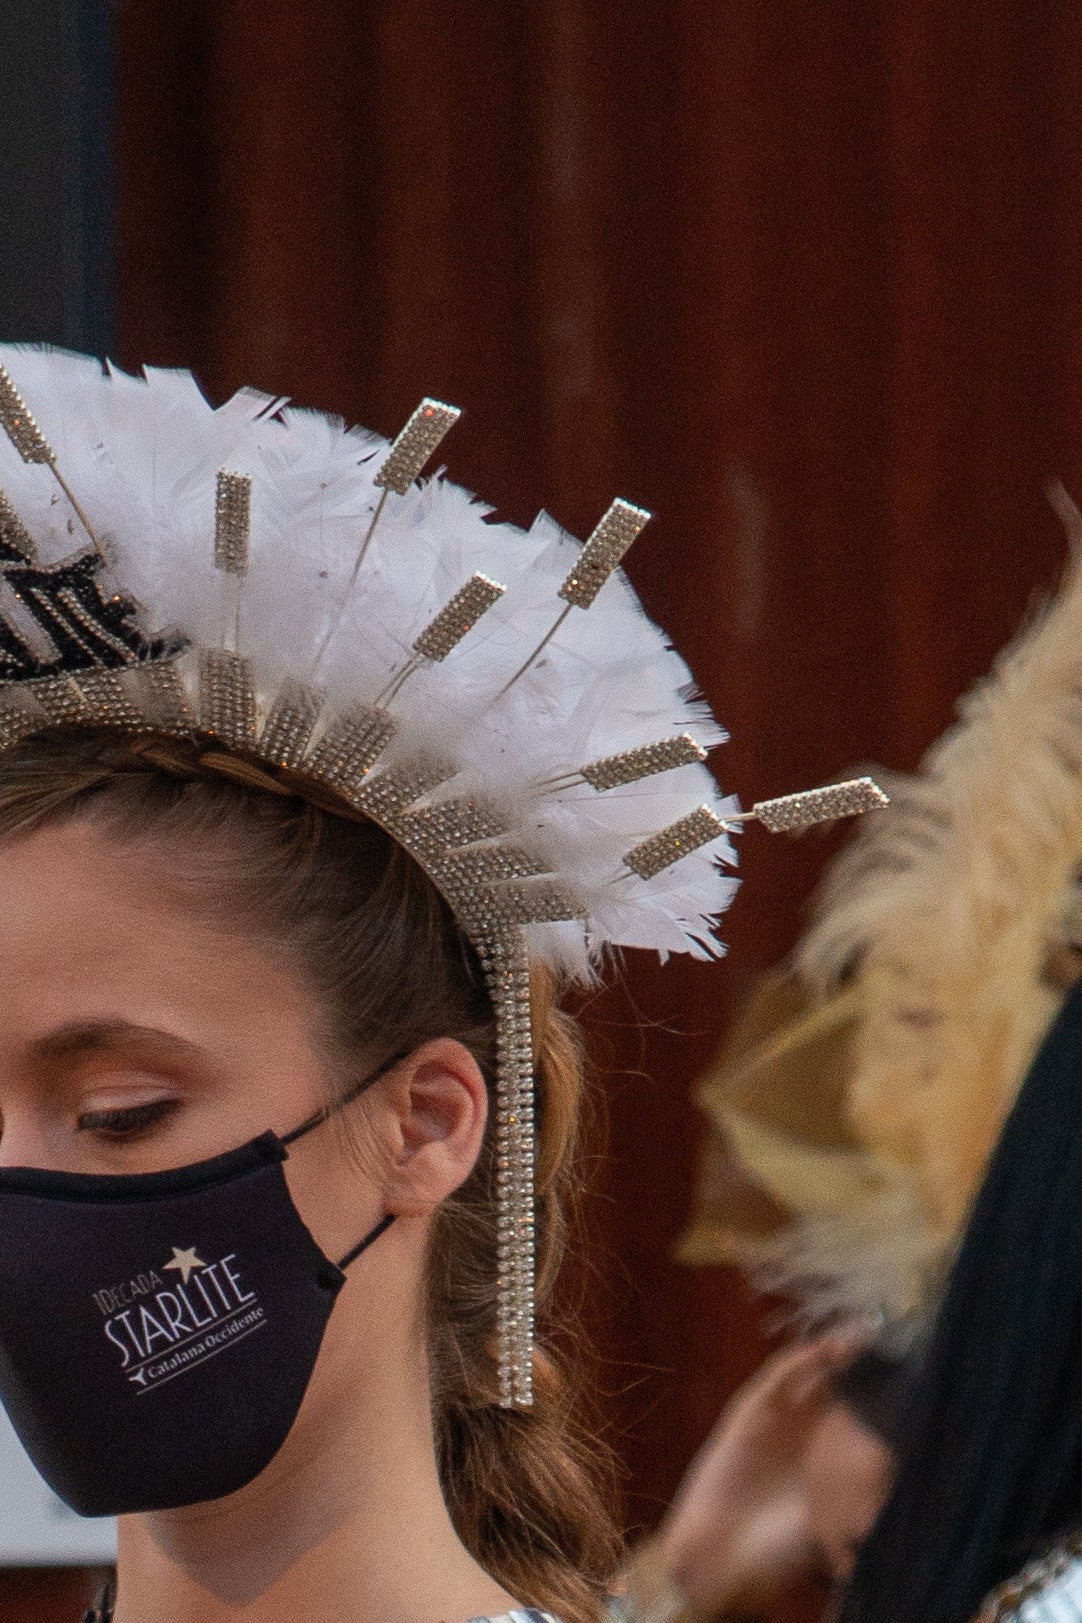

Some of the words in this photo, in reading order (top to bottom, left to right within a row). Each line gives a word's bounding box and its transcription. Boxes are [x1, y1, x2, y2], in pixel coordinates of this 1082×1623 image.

[104, 1253, 255, 1367] STARLITE
[147, 1341, 206, 1379] Catalana
[204, 1305, 264, 1348] Occidente
